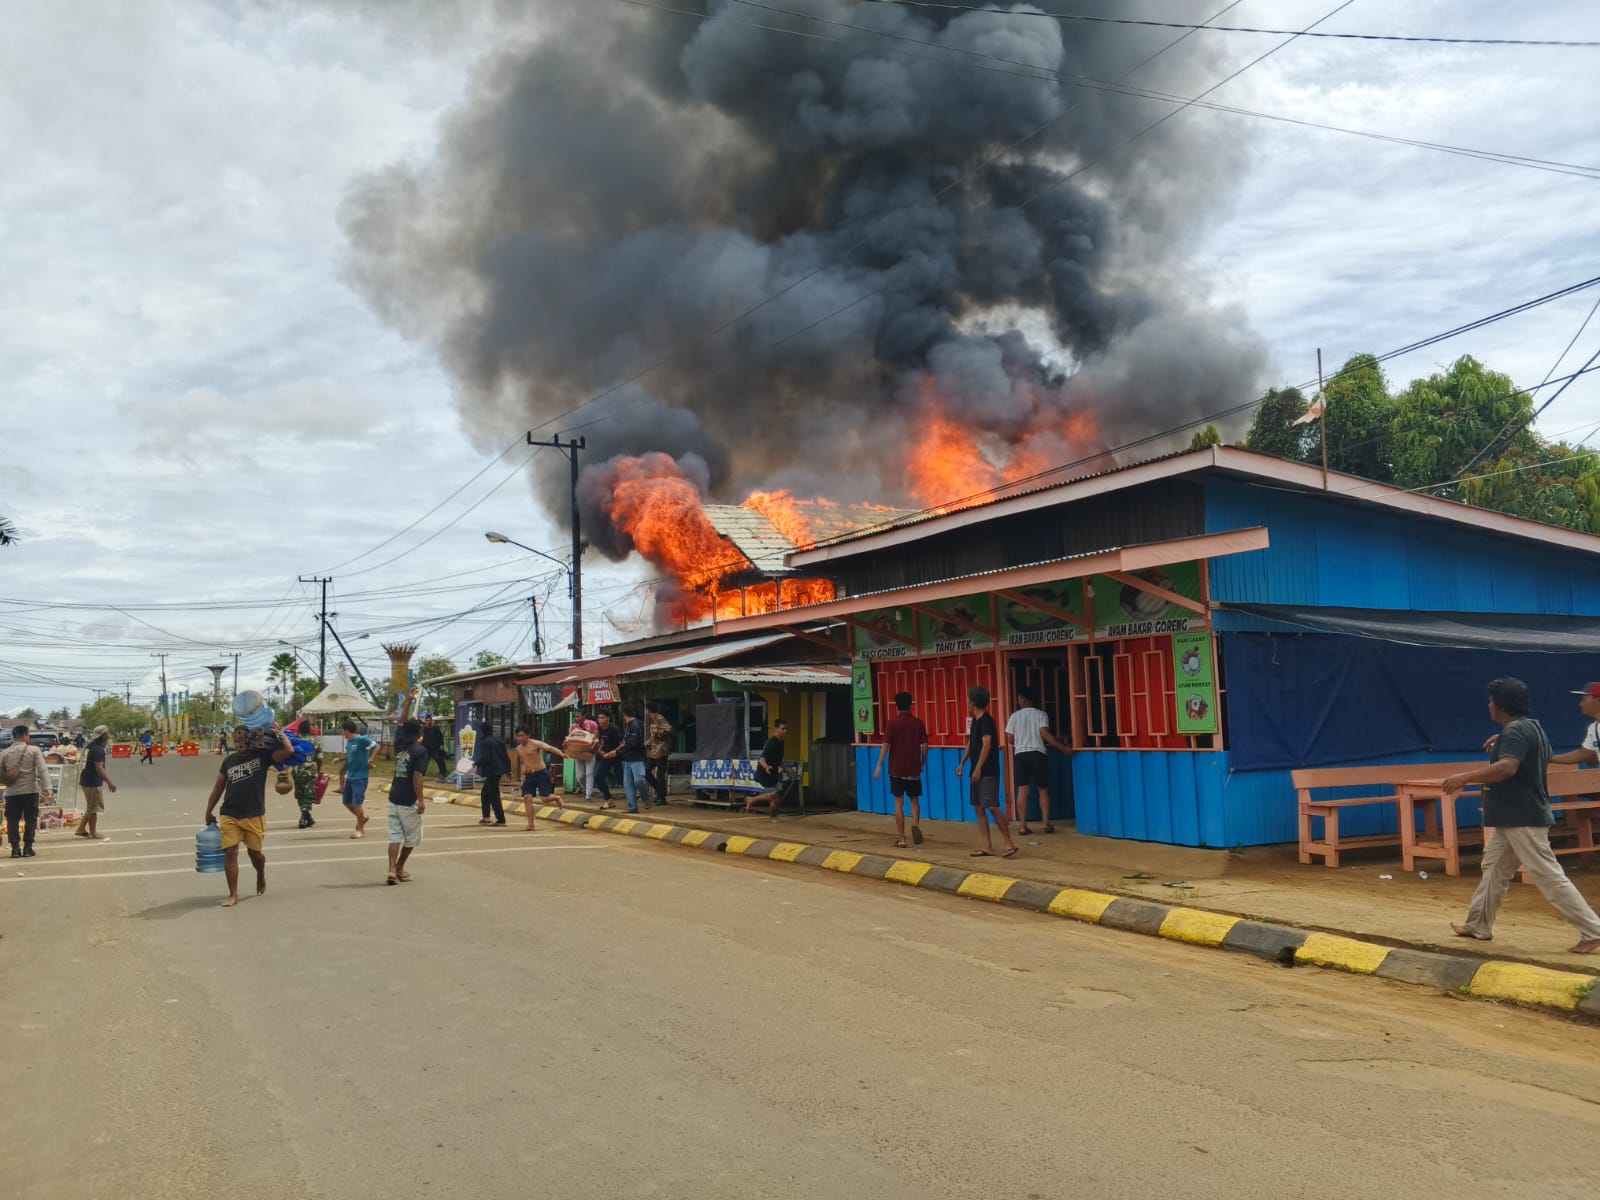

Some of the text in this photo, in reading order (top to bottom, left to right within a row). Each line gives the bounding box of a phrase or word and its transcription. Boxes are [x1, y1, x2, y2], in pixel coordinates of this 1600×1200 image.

[936, 640, 972, 653] TAHU TEK
[877, 647, 906, 658] GORENG
[594, 690, 611, 701] SOTO
